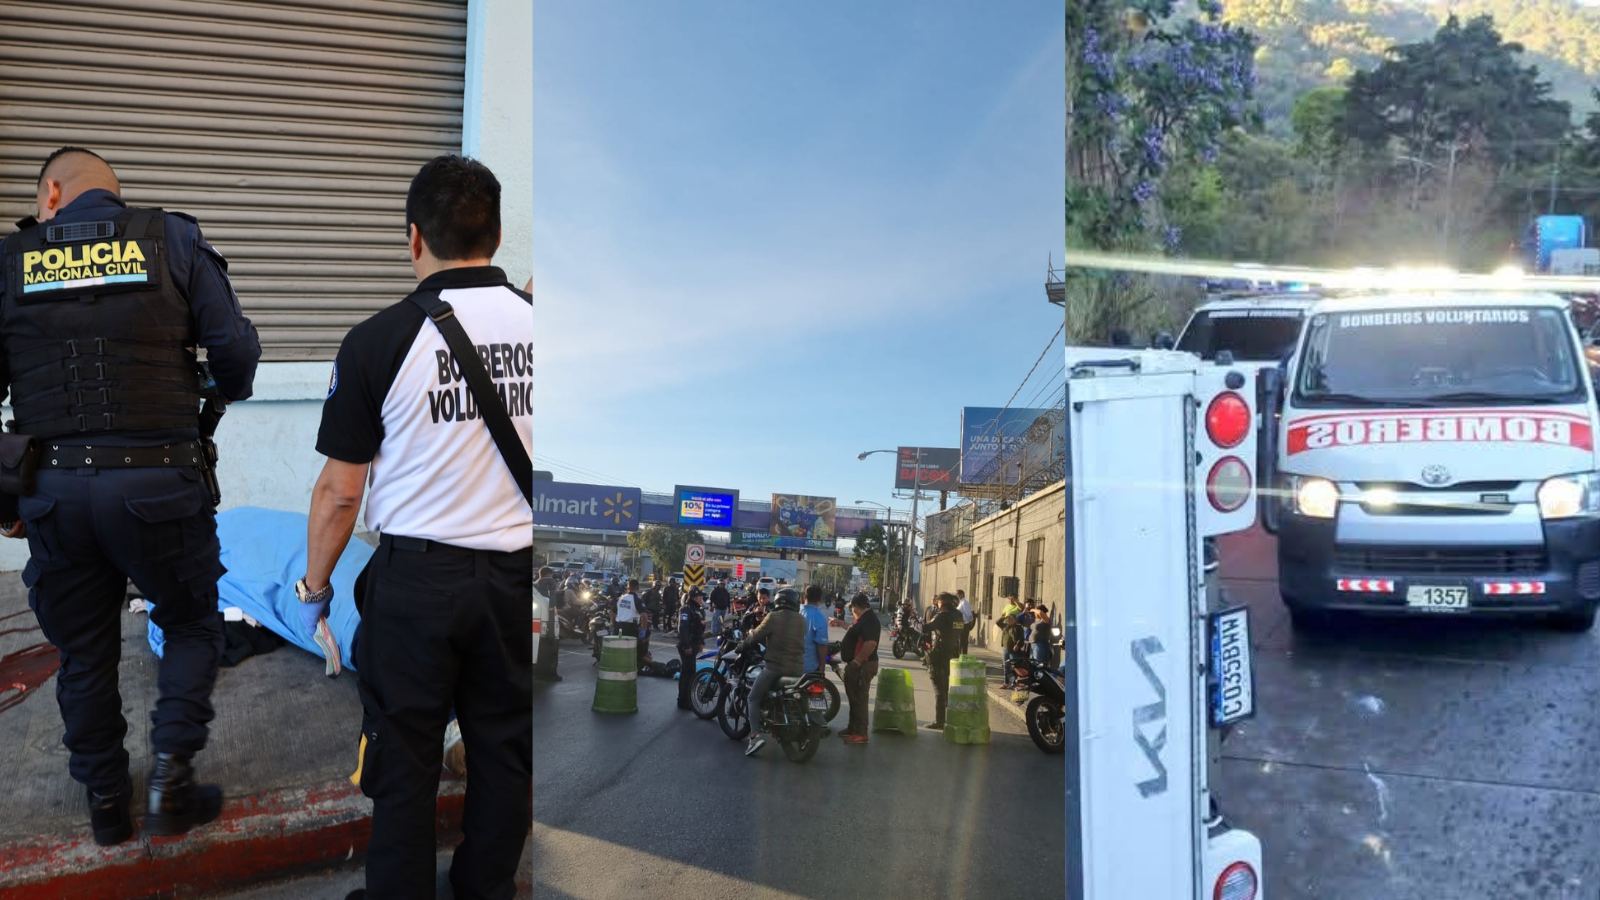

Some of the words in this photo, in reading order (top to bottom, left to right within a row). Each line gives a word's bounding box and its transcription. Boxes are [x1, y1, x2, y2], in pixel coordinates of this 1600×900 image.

[23, 240, 146, 273] POLICIA
[24, 265, 103, 285] NACIONAL
[105, 261, 147, 275] CIVIL
[1340, 311, 1423, 328] BOMBEROS
[1425, 309, 1530, 325] VOLUNTARIOS
[435, 342, 533, 385] BOBEROS
[428, 381, 533, 424] VOLUARIO
[969, 443, 998, 451] JUNTO
[901, 468, 950, 482] BACON
[1424, 588, 1467, 605] 1357
